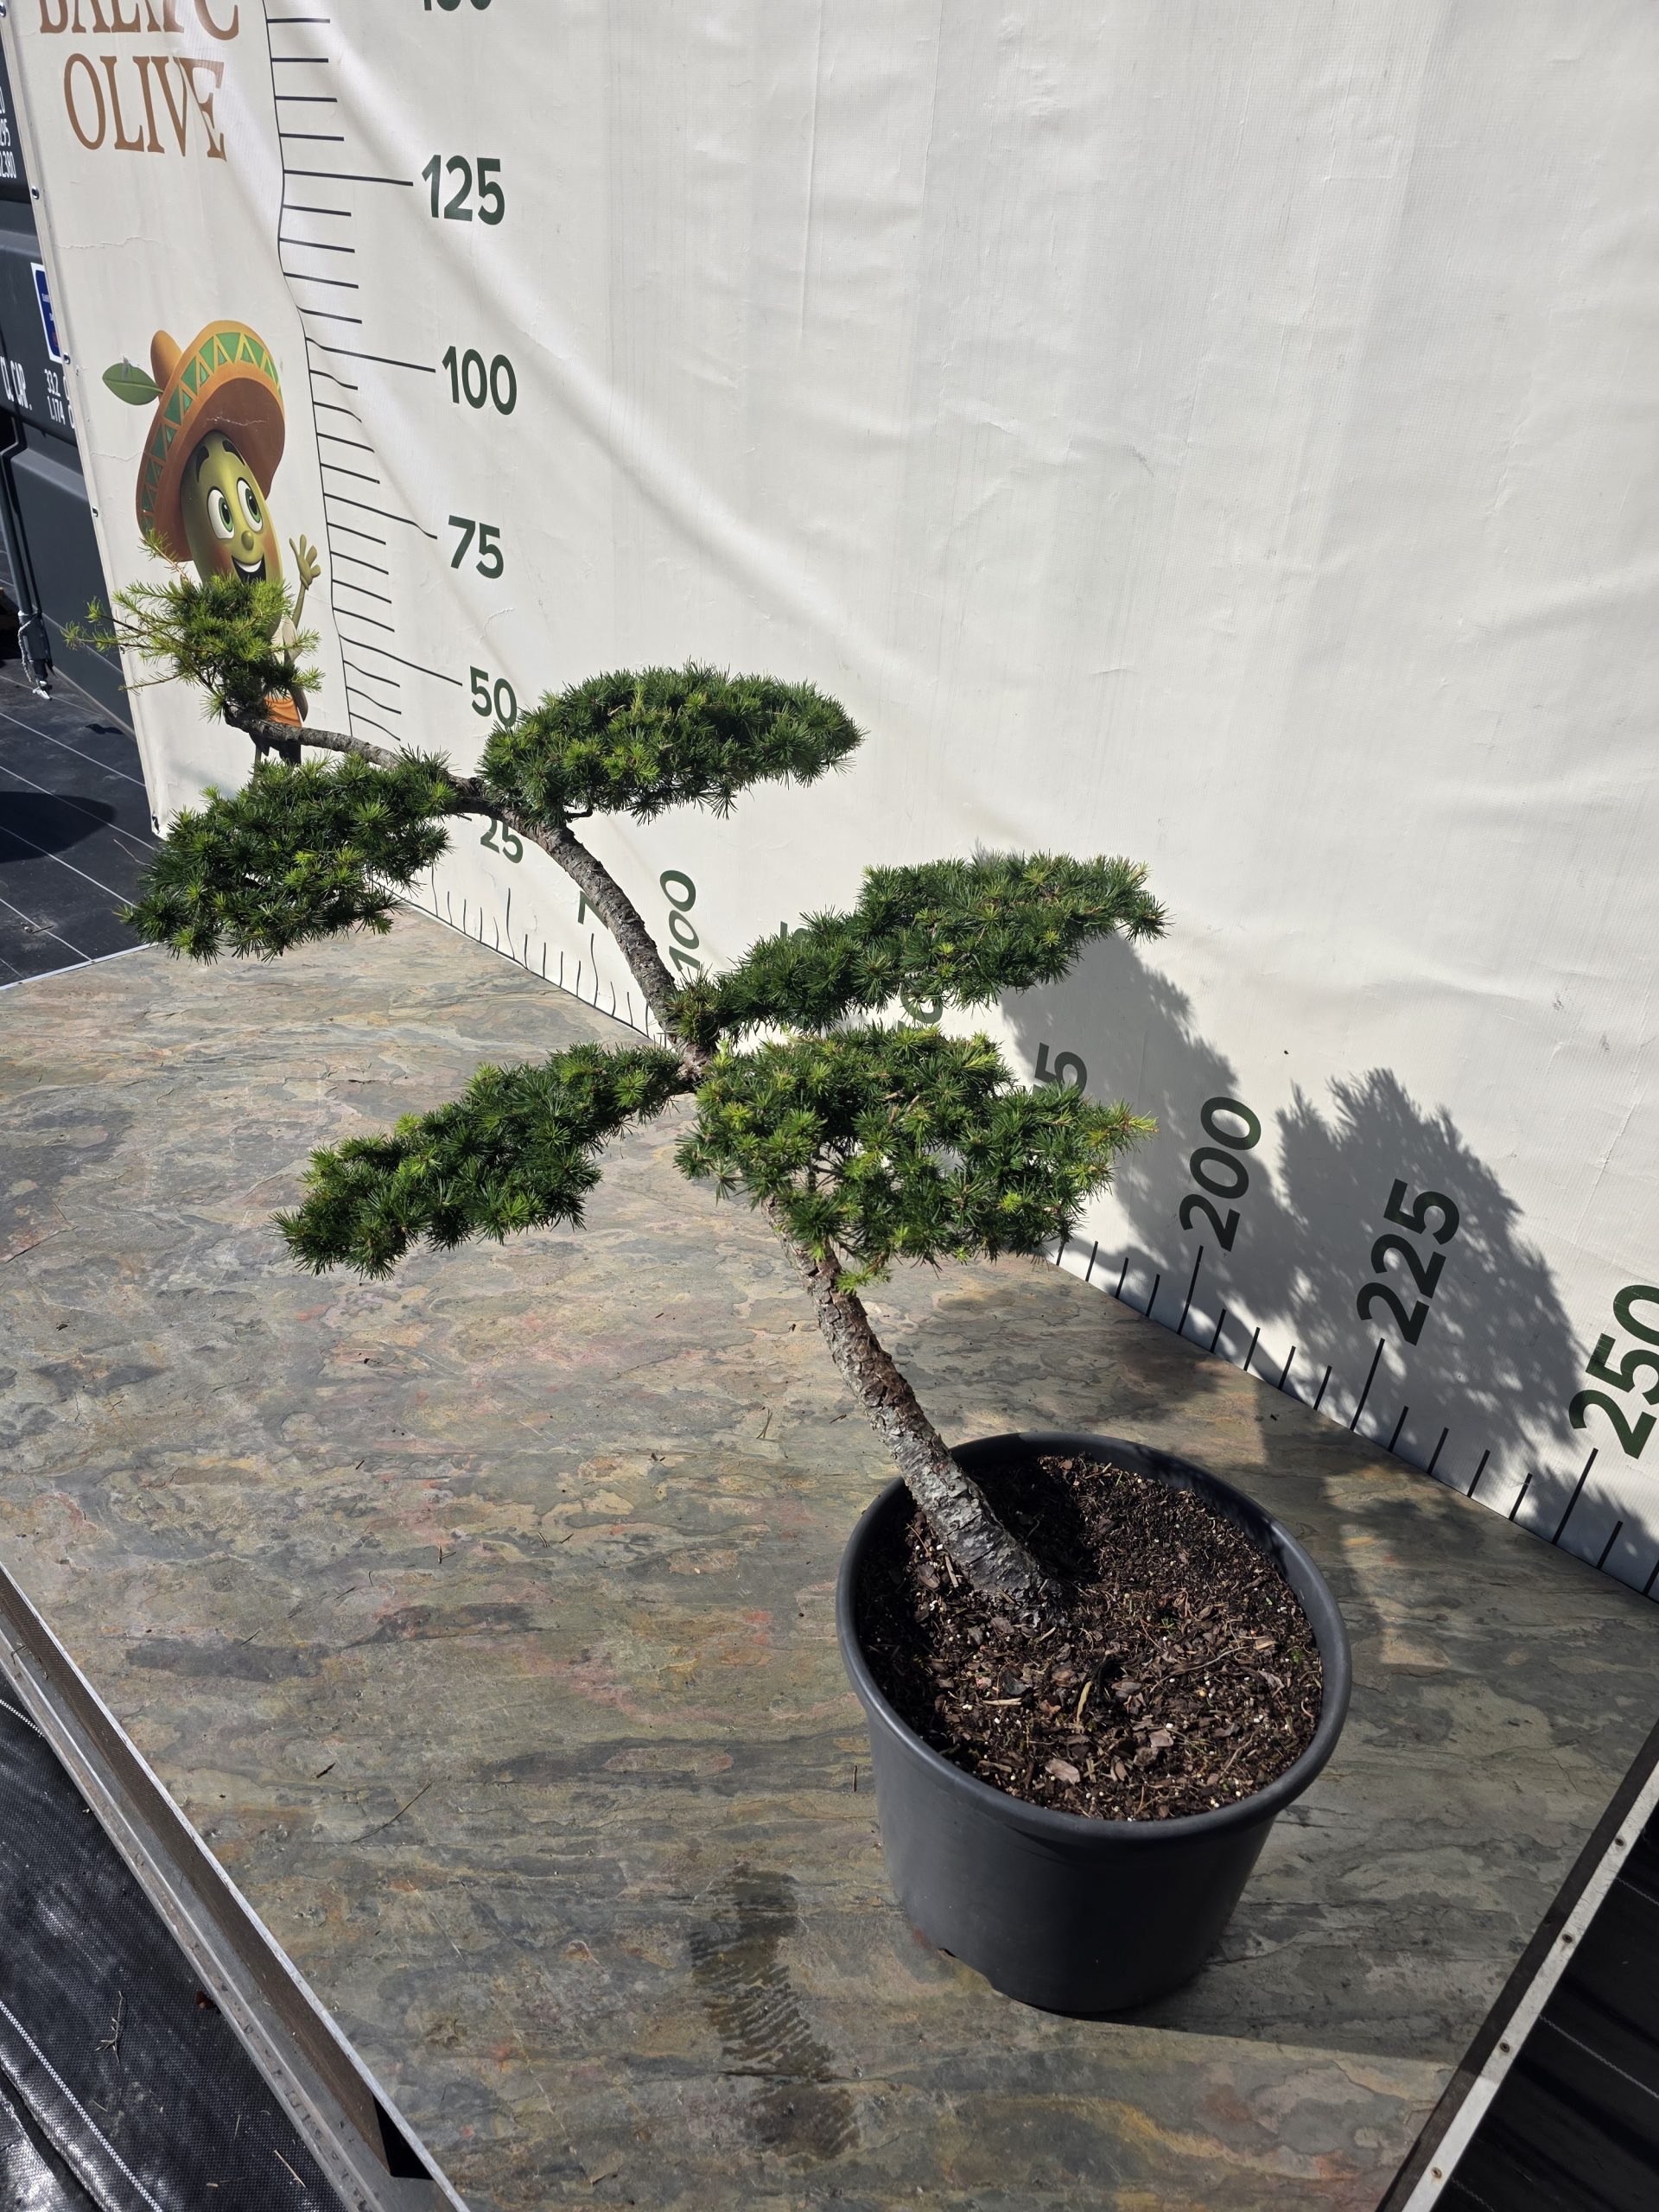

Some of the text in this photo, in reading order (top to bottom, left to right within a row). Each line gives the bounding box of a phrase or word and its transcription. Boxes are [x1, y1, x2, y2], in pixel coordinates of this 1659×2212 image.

[63, 53, 227, 162] OLIVE
[422, 154, 505, 226] 125
[442, 345, 518, 415] 100
[448, 514, 505, 579] 75
[469, 665, 518, 727] 50
[480, 812, 524, 864] 25
[659, 869, 701, 972] 100
[1179, 1096, 1262, 1252] 200
[1356, 1178, 1460, 1346] 225
